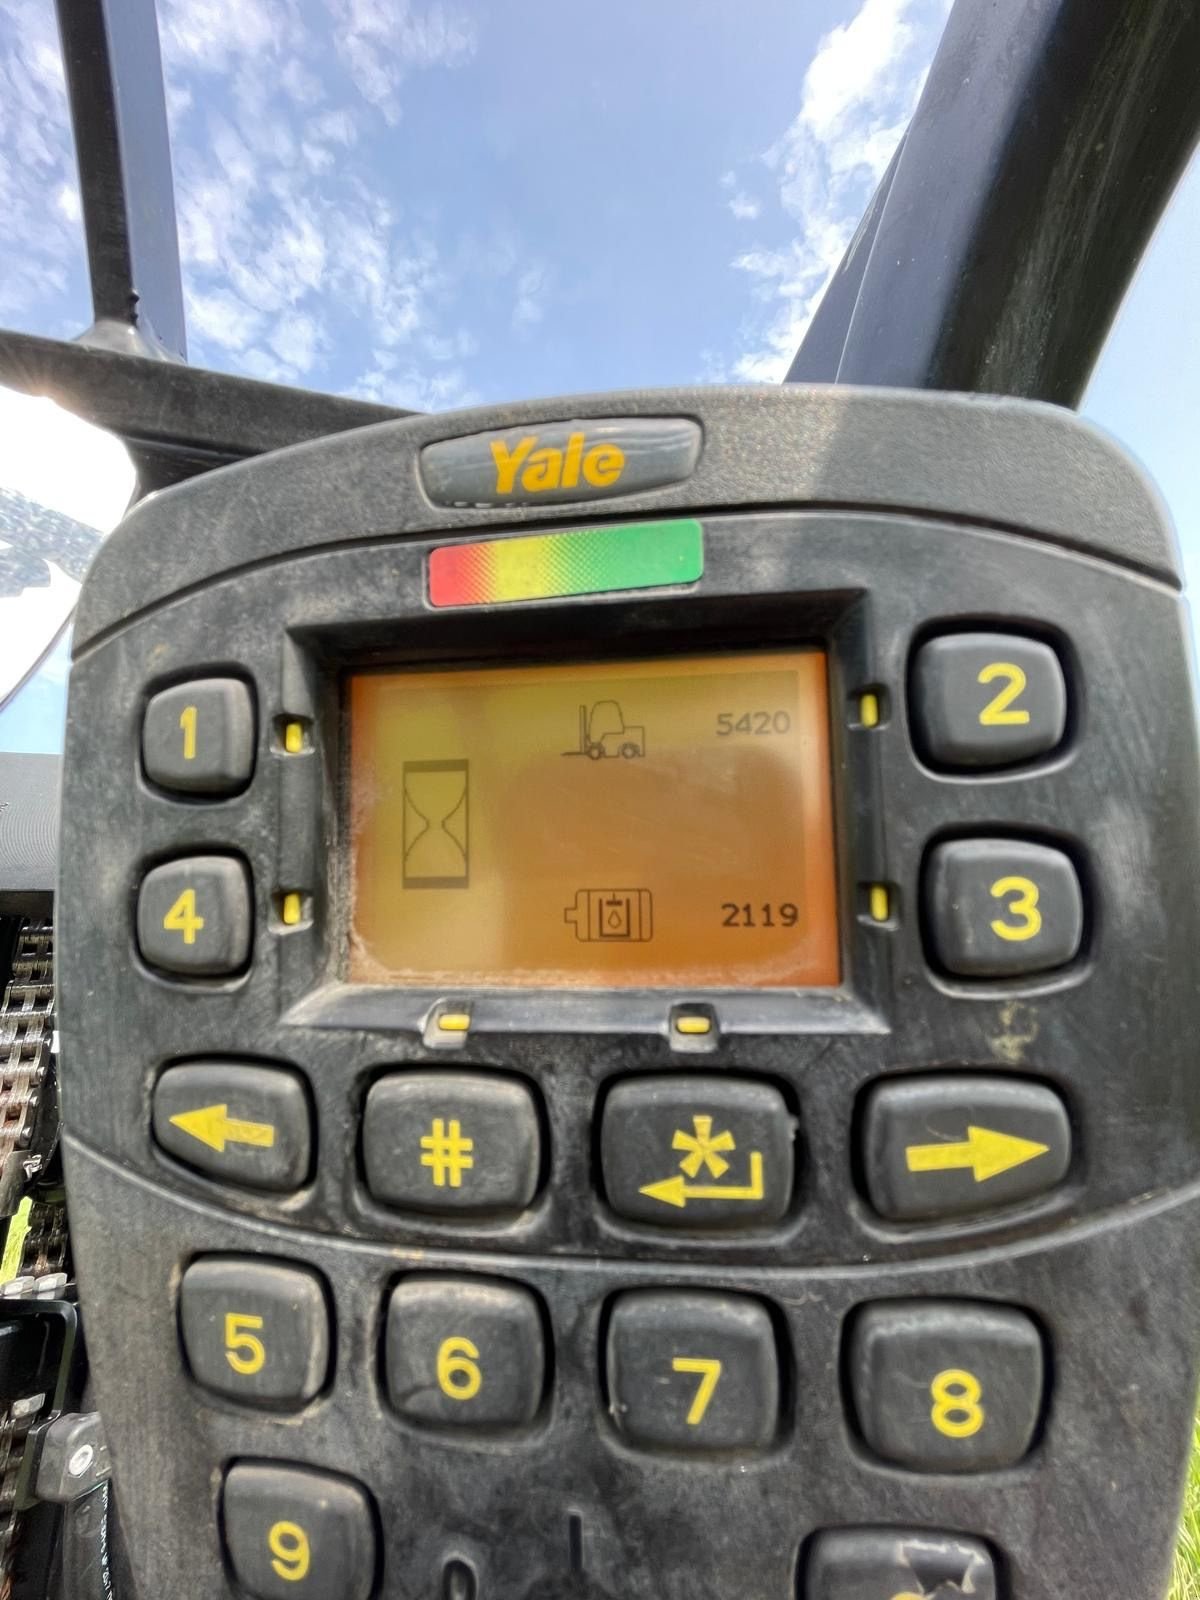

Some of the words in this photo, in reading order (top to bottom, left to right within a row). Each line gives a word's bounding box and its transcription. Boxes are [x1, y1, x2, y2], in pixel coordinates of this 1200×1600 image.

[490, 432, 626, 496] Yale
[715, 711, 791, 736] 5420
[977, 662, 1030, 726] 2
[179, 706, 197, 759] 1
[163, 889, 204, 944] 4
[720, 903, 799, 928] 2119
[990, 876, 1042, 942] 3
[224, 1312, 266, 1375] 5
[436, 1336, 482, 1400] 6
[672, 1357, 722, 1425] 7
[930, 1368, 985, 1438] 8
[268, 1520, 311, 1581] 9
